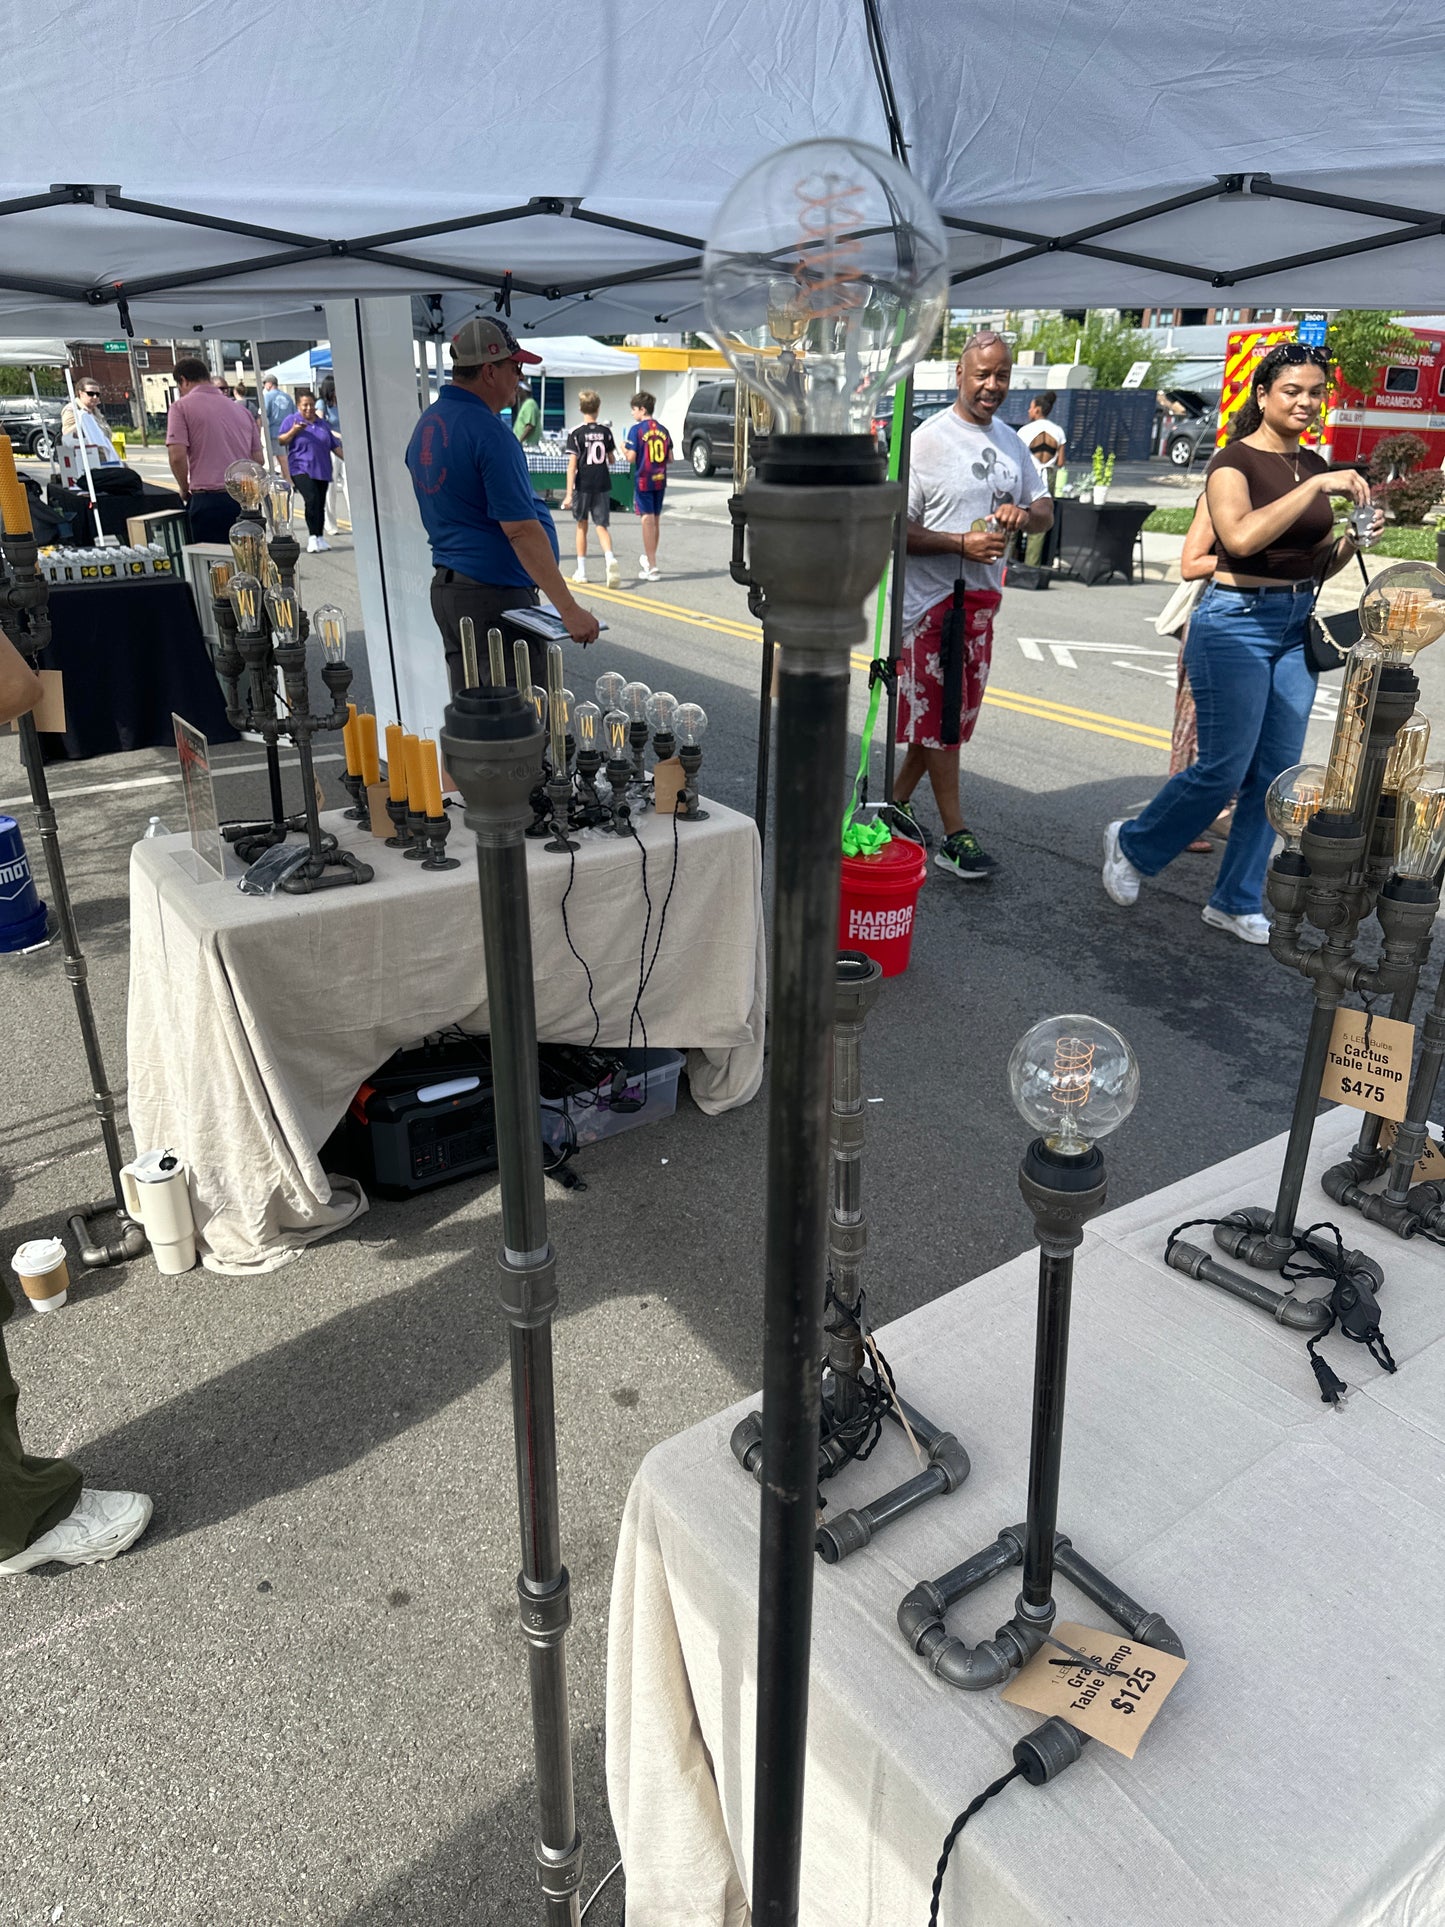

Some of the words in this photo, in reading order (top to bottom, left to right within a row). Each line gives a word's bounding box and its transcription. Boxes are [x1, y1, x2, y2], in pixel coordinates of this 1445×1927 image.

[1418, 355, 1436, 367] FIRE
[1375, 394, 1423, 409] PARAMEDICS
[1339, 412, 1353, 422] CALL
[585, 441, 606, 465] 10
[648, 440, 665, 463] 10
[849, 905, 913, 926] HARBOR
[848, 919, 912, 941] FREIGHT
[1344, 1044, 1389, 1064] Cactus
[1370, 1039, 1393, 1051] Bulbs
[1329, 1052, 1363, 1070] Table
[1367, 1062, 1403, 1083] Lamp
[1340, 1077, 1385, 1102] $475
[1067, 1655, 1102, 1688] Gras
[1070, 1679, 1105, 1710] Table
[1110, 1667, 1156, 1715] $125
